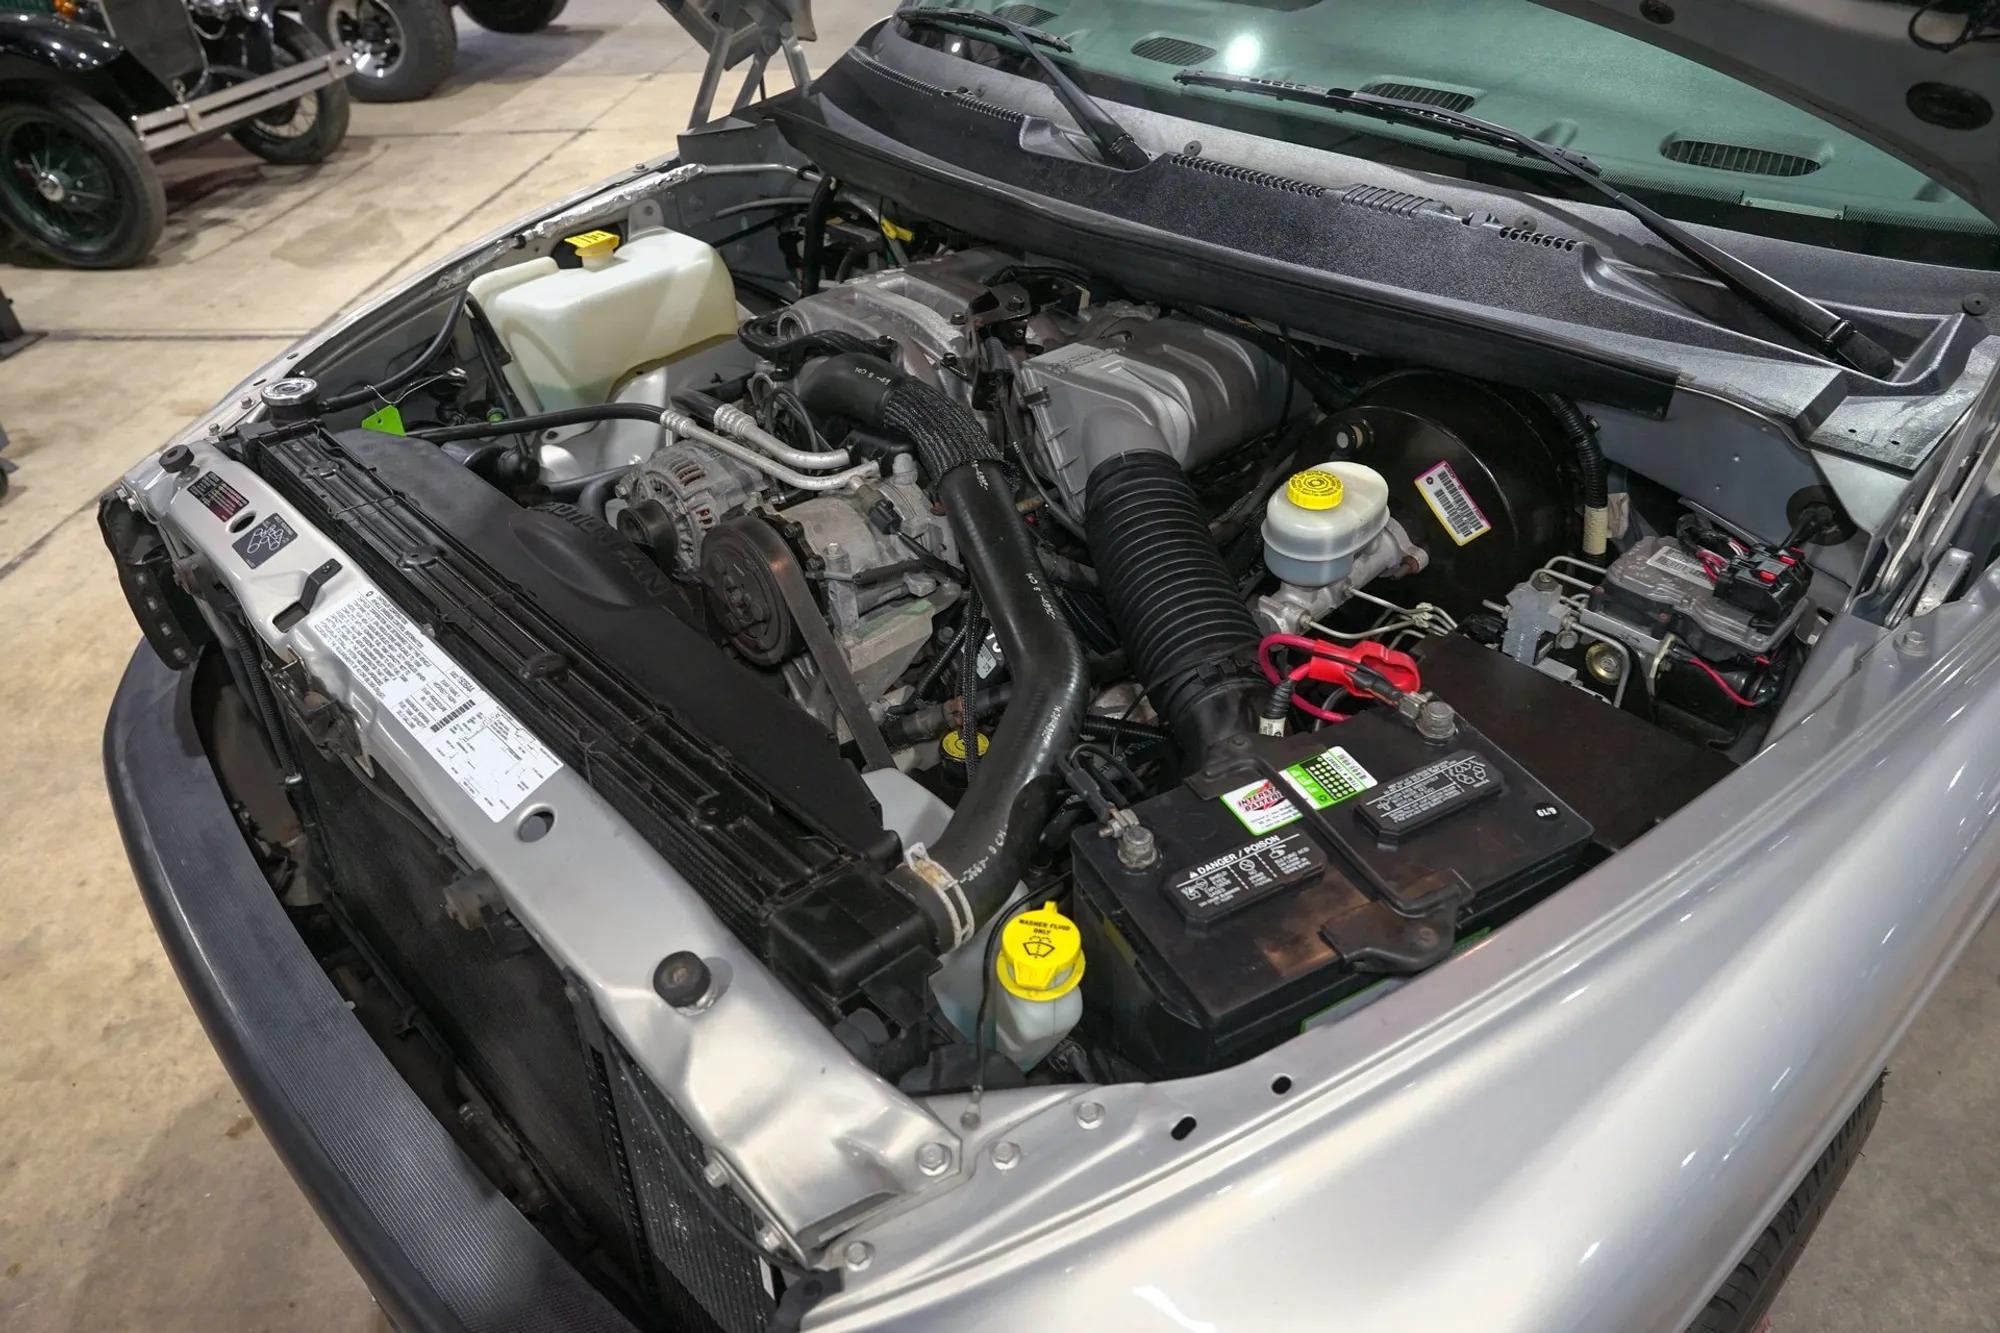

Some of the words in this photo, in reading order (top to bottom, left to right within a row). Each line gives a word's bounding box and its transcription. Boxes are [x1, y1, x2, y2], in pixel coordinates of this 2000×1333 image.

[1238, 786, 1280, 807] INTERST
[1244, 791, 1285, 812] BATTERI
[1197, 853, 1237, 874] DANGER
[1244, 835, 1280, 854] POISON
[1019, 919, 1048, 928] WASHER
[1050, 923, 1071, 931] FLUID
